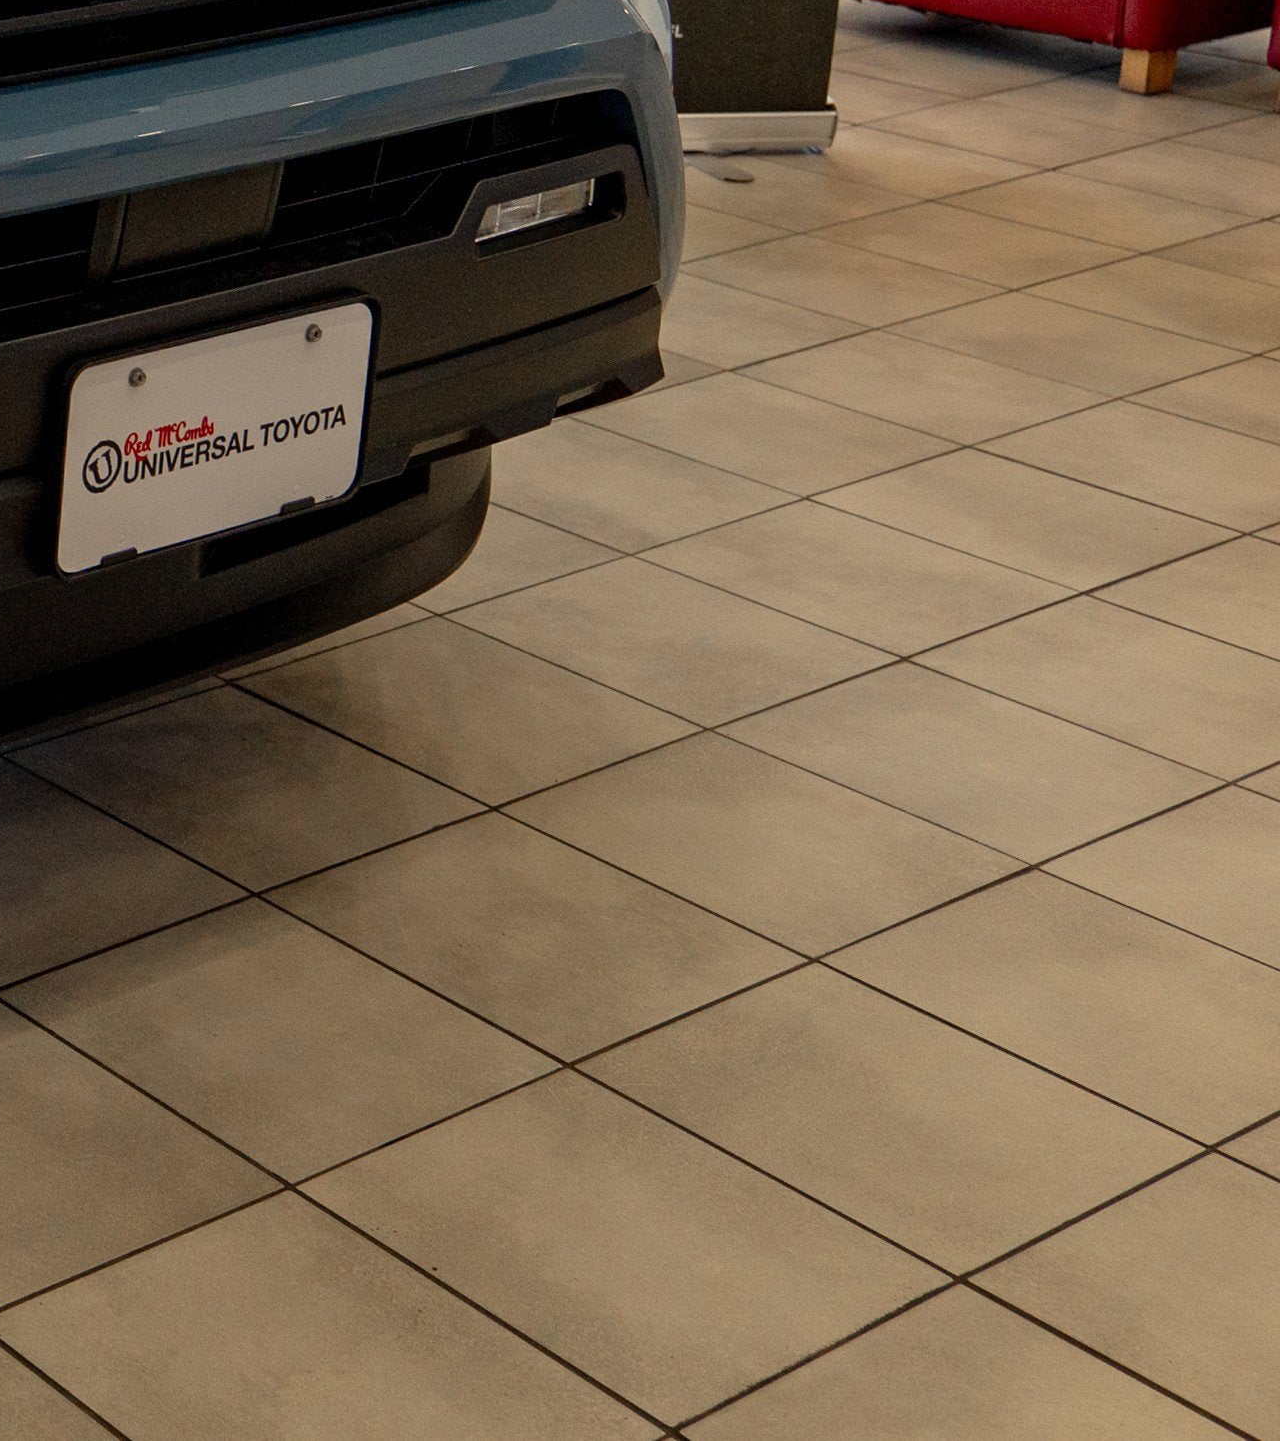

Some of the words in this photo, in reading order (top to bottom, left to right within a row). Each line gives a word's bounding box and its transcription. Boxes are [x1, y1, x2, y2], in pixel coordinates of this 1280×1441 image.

[122, 429, 256, 484] UNIVERSAL
[259, 404, 348, 448] TOYOTA
[124, 432, 152, 462] Red
[154, 415, 215, 449] McCombs
